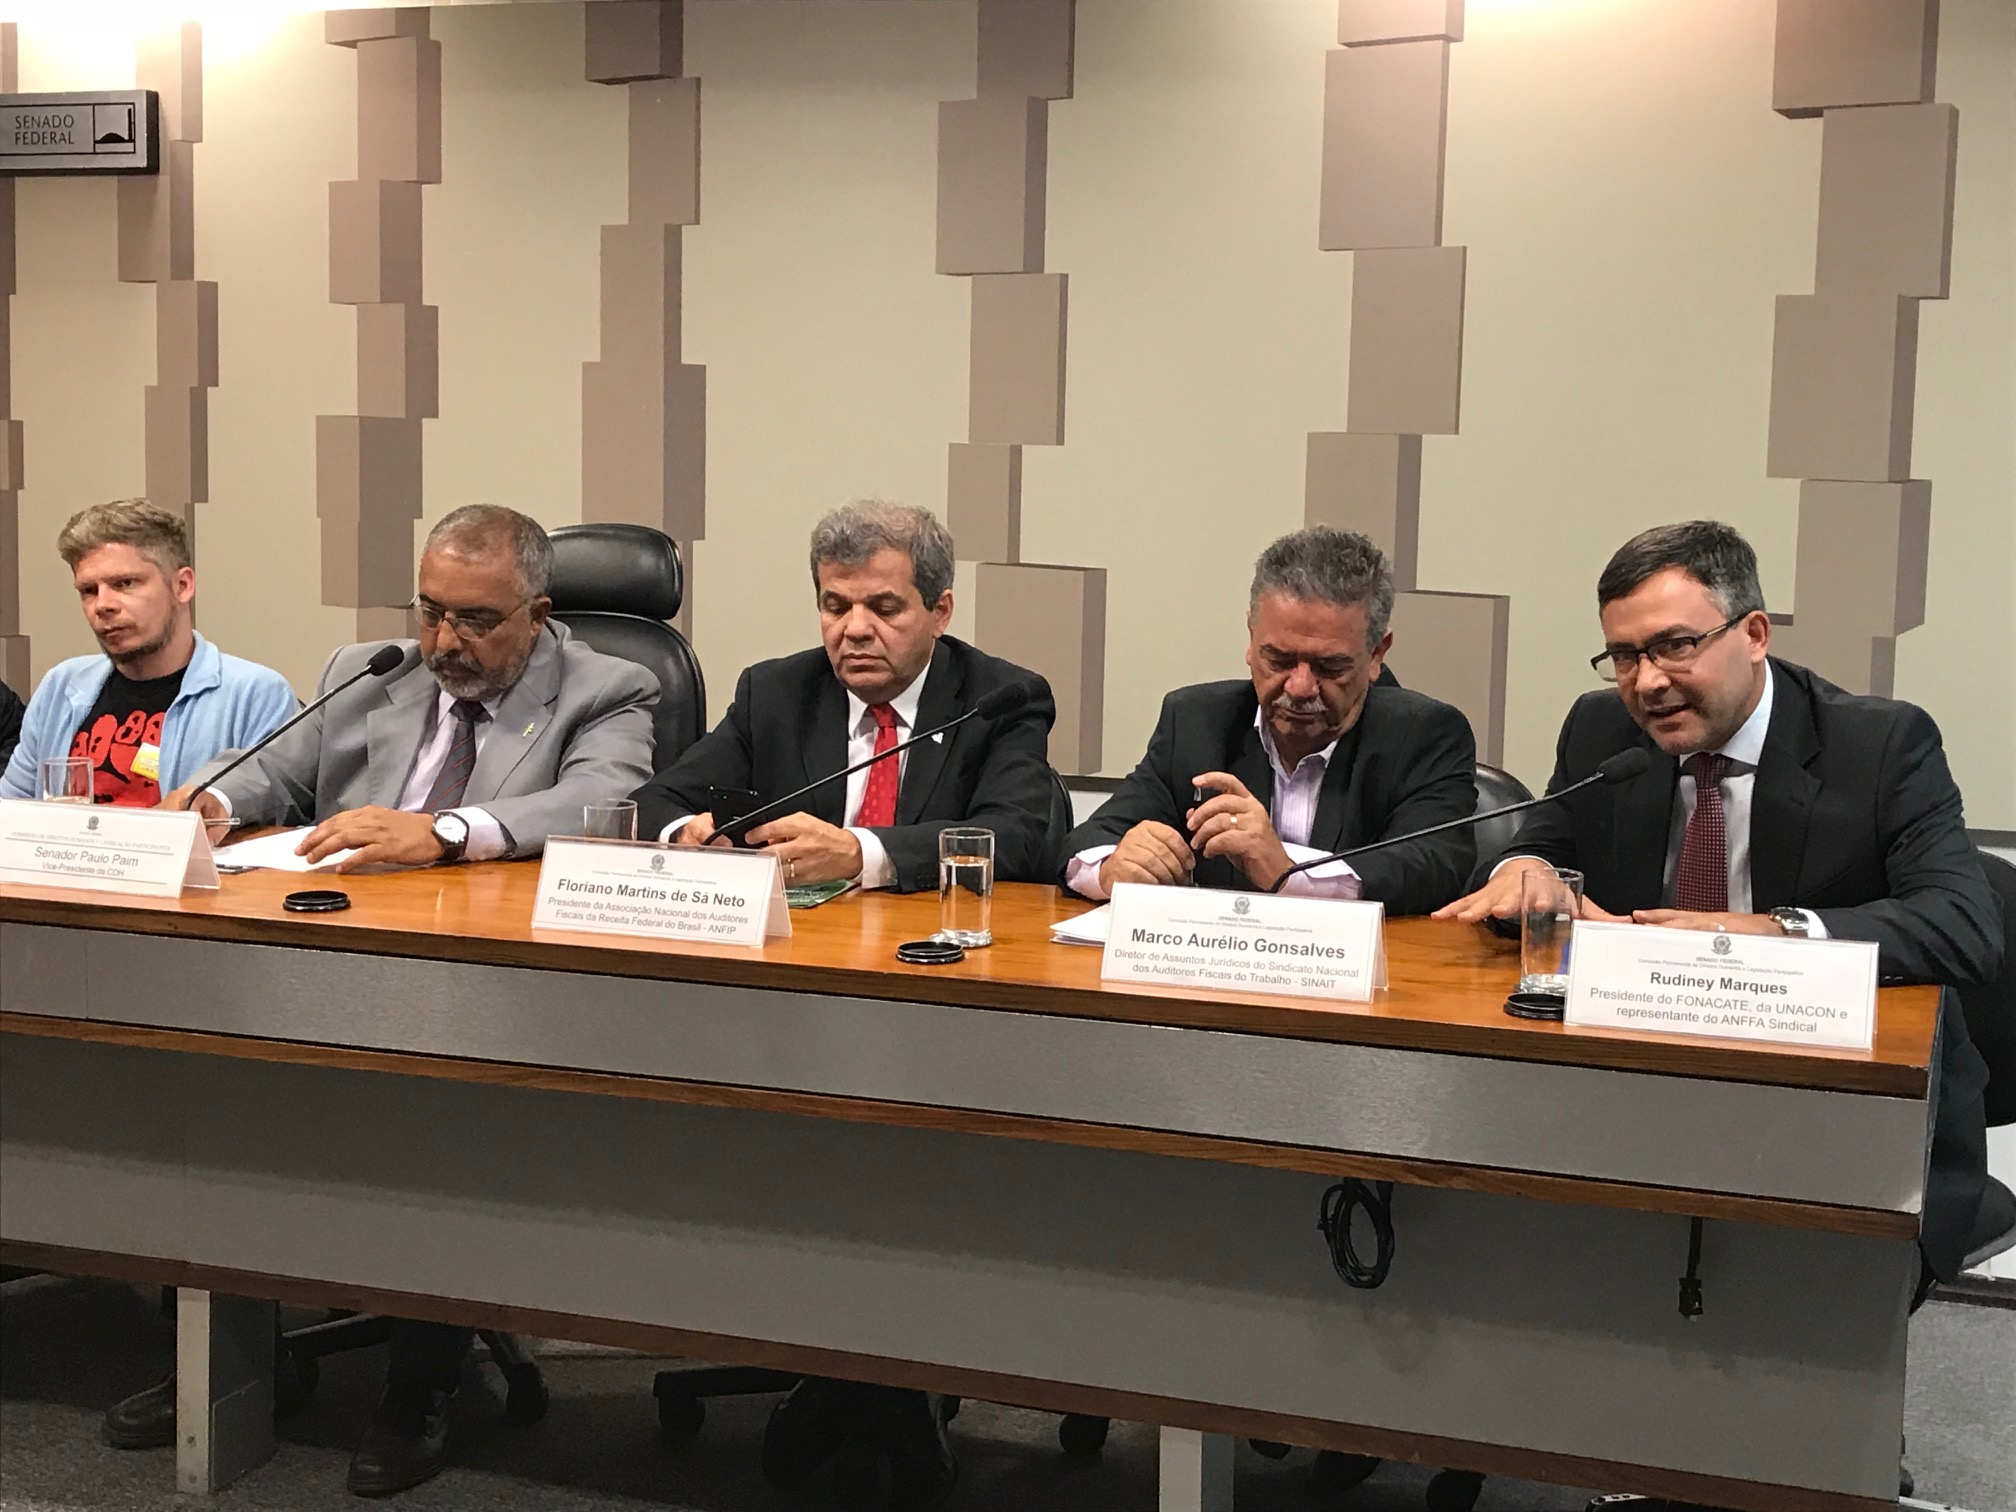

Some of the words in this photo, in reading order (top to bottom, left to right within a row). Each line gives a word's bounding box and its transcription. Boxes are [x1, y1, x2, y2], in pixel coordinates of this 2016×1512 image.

[15, 114, 74, 129] SENADO
[15, 131, 74, 145] FEDERAL
[35, 846, 78, 861] Senador
[80, 850, 109, 864] Paulo
[111, 853, 139, 867] Paim
[42, 862, 95, 874] Vice-Presidente
[96, 865, 105, 875] da
[106, 867, 124, 877] CDH
[558, 878, 613, 895] Floriano
[616, 884, 666, 900] Martins
[671, 889, 687, 902] de
[692, 891, 709, 904] Sá
[713, 893, 745, 907] Neto
[548, 897, 591, 909] Presidente
[593, 901, 603, 910] da
[605, 902, 652, 916] Associação
[654, 907, 690, 918] Nacional
[692, 909, 707, 920] dos
[708, 912, 748, 924] Auditores
[556, 910, 584, 920] Fiscais
[586, 912, 596, 921] da
[598, 914, 629, 925] Receita
[631, 916, 663, 927] Federal
[665, 919, 675, 929] do
[678, 921, 701, 931] Brasil
[708, 924, 736, 935] ANFIP
[1131, 928, 1183, 946] Marco
[1187, 933, 1248, 951] Aurélio
[1254, 938, 1345, 959] Gonsalves
[1114, 949, 1146, 960] Diretor
[1148, 951, 1160, 961] de
[1162, 952, 1206, 965] Assuntos
[1208, 956, 1251, 969] Jurídicos
[1253, 960, 1266, 970] do
[1268, 961, 1313, 974] Sindicato
[1315, 965, 1359, 978] Nacional
[1132, 963, 1149, 973] dos
[1151, 965, 1196, 977] Auditores
[1198, 968, 1232, 980] Fiscais
[1234, 972, 1247, 981] do
[1249, 972, 1291, 985] Trabalho
[1300, 977, 1337, 989] SINAIT
[1650, 972, 1715, 991] Rudiney
[1719, 977, 1788, 995] Marques
[1590, 987, 1653, 1003] Presidente
[1657, 994, 1672, 1005] do
[1676, 994, 1752, 1013] FONACATE,
[1756, 1002, 1772, 1013] da
[1776, 1003, 1836, 1019] UNACON
[1840, 1011, 1848, 1019] e
[1616, 1007, 1699, 1023] representante
[1703, 1013, 1718, 1025] do
[1721, 1015, 1765, 1029] ANFFA
[1768, 1018, 1817, 1033] Sindical
